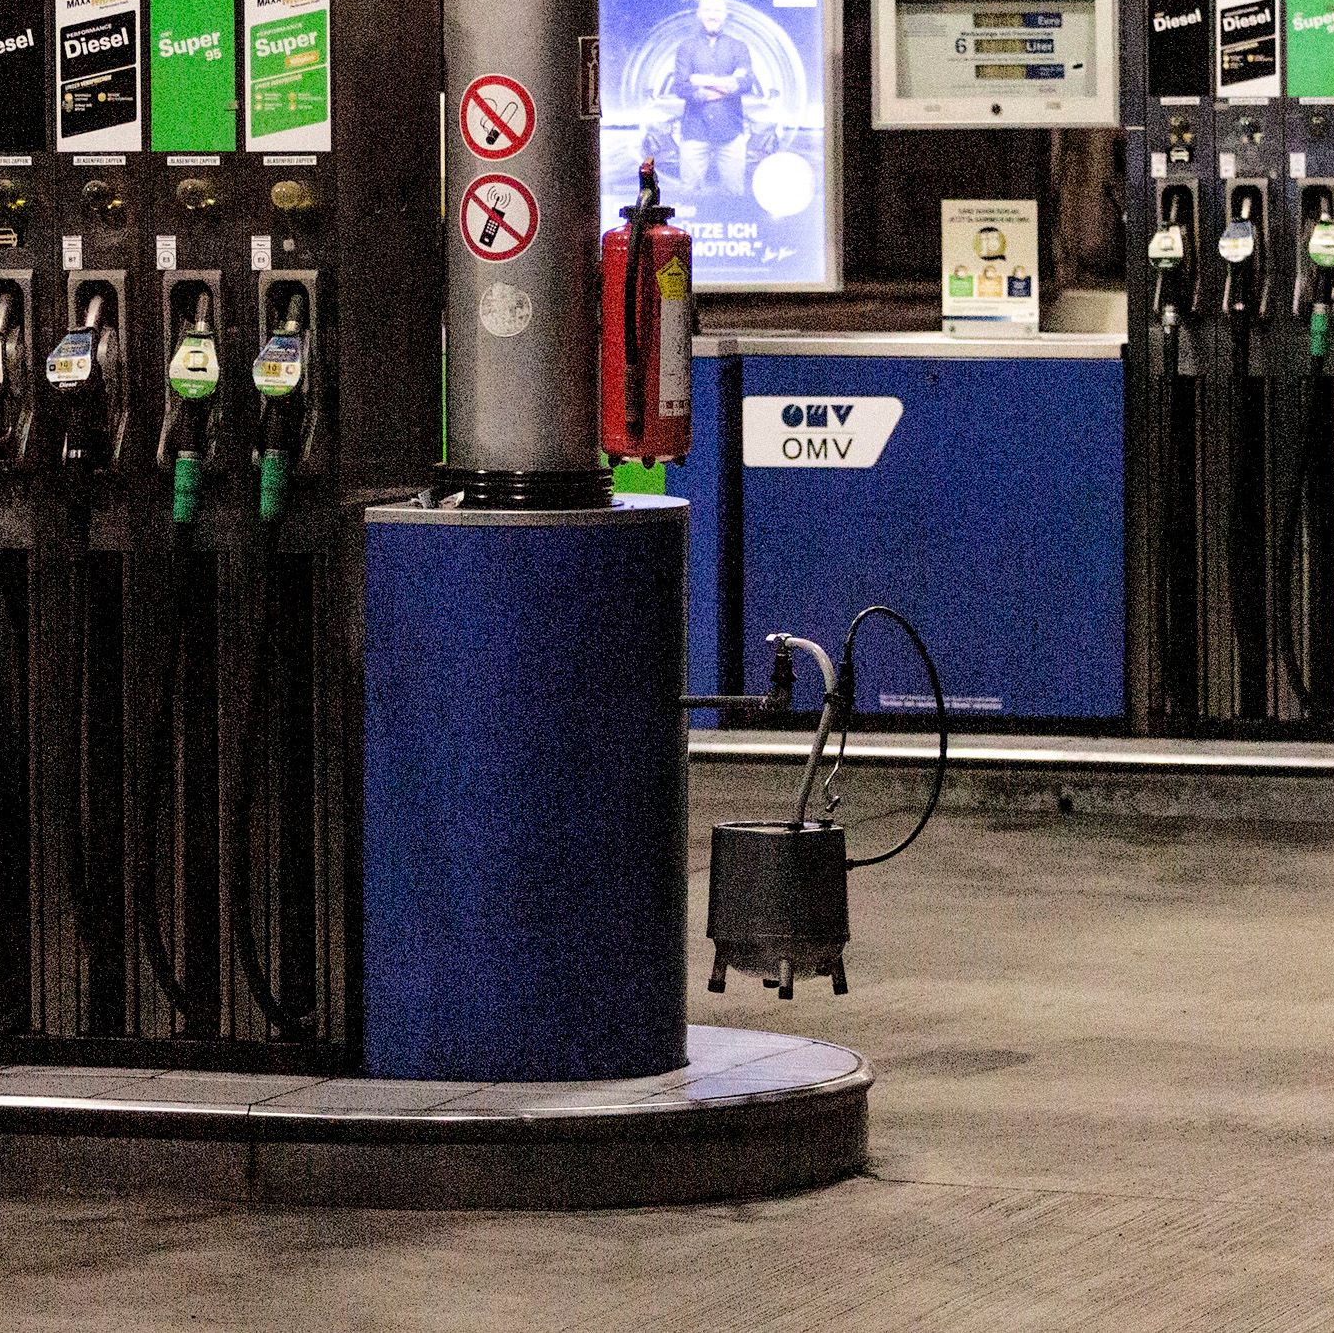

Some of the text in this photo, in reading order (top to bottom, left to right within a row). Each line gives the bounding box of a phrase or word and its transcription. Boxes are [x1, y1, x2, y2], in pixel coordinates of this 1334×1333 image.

[1153, 8, 1202, 32] Diesel
[1223, 8, 1271, 32] Diesel
[64, 27, 130, 60] Diesel
[158, 31, 221, 58] Super
[205, 48, 222, 61] 95
[255, 31, 317, 58] Super
[955, 38, 967, 54] 6
[782, 437, 853, 460] OMV
